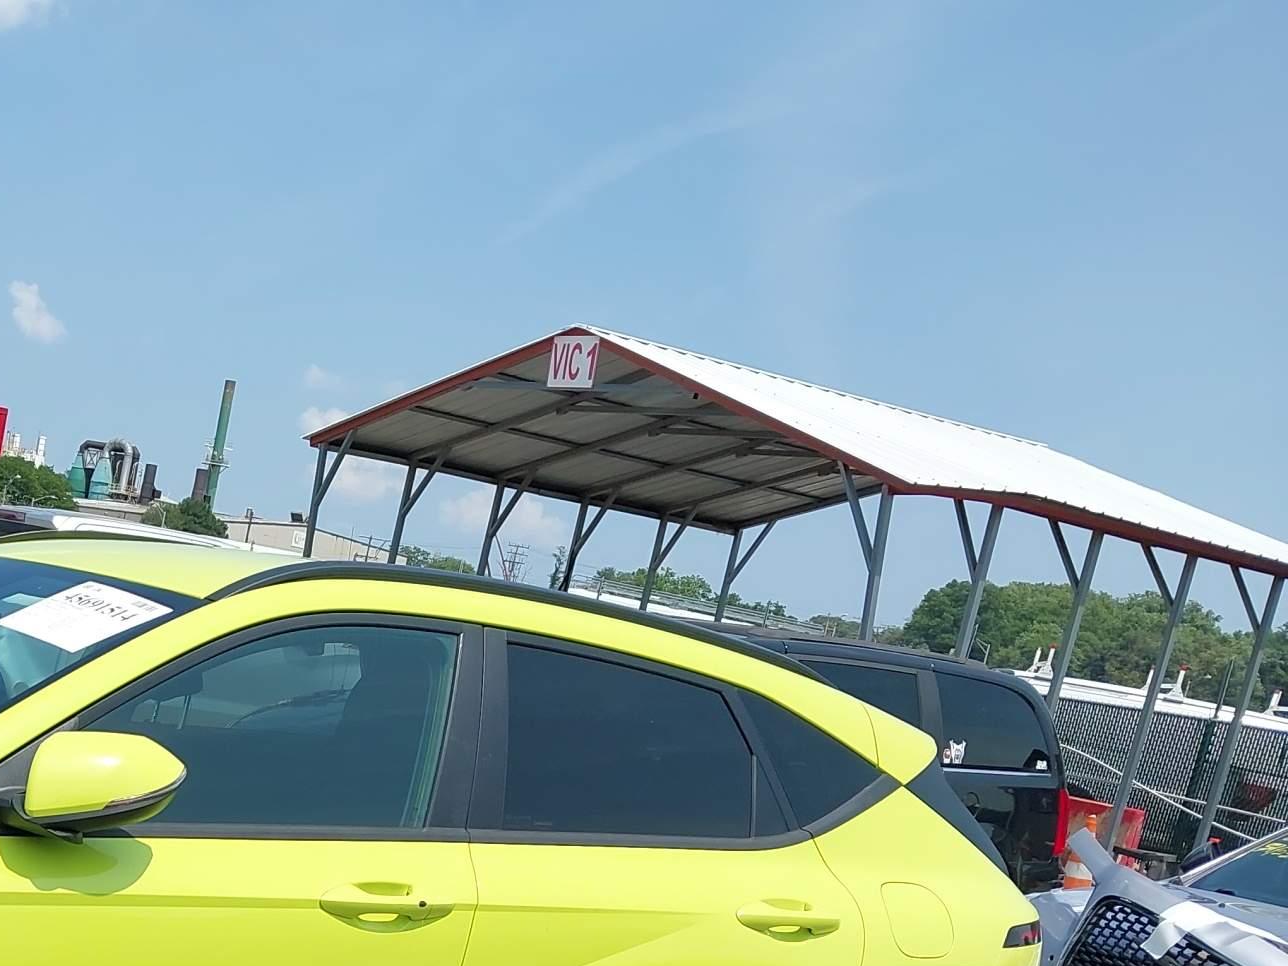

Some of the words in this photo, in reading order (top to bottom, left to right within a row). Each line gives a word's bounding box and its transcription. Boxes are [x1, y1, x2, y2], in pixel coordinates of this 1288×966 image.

[553, 342, 582, 380] VIC
[586, 342, 599, 380] 1
[64, 593, 140, 621] 45691514
